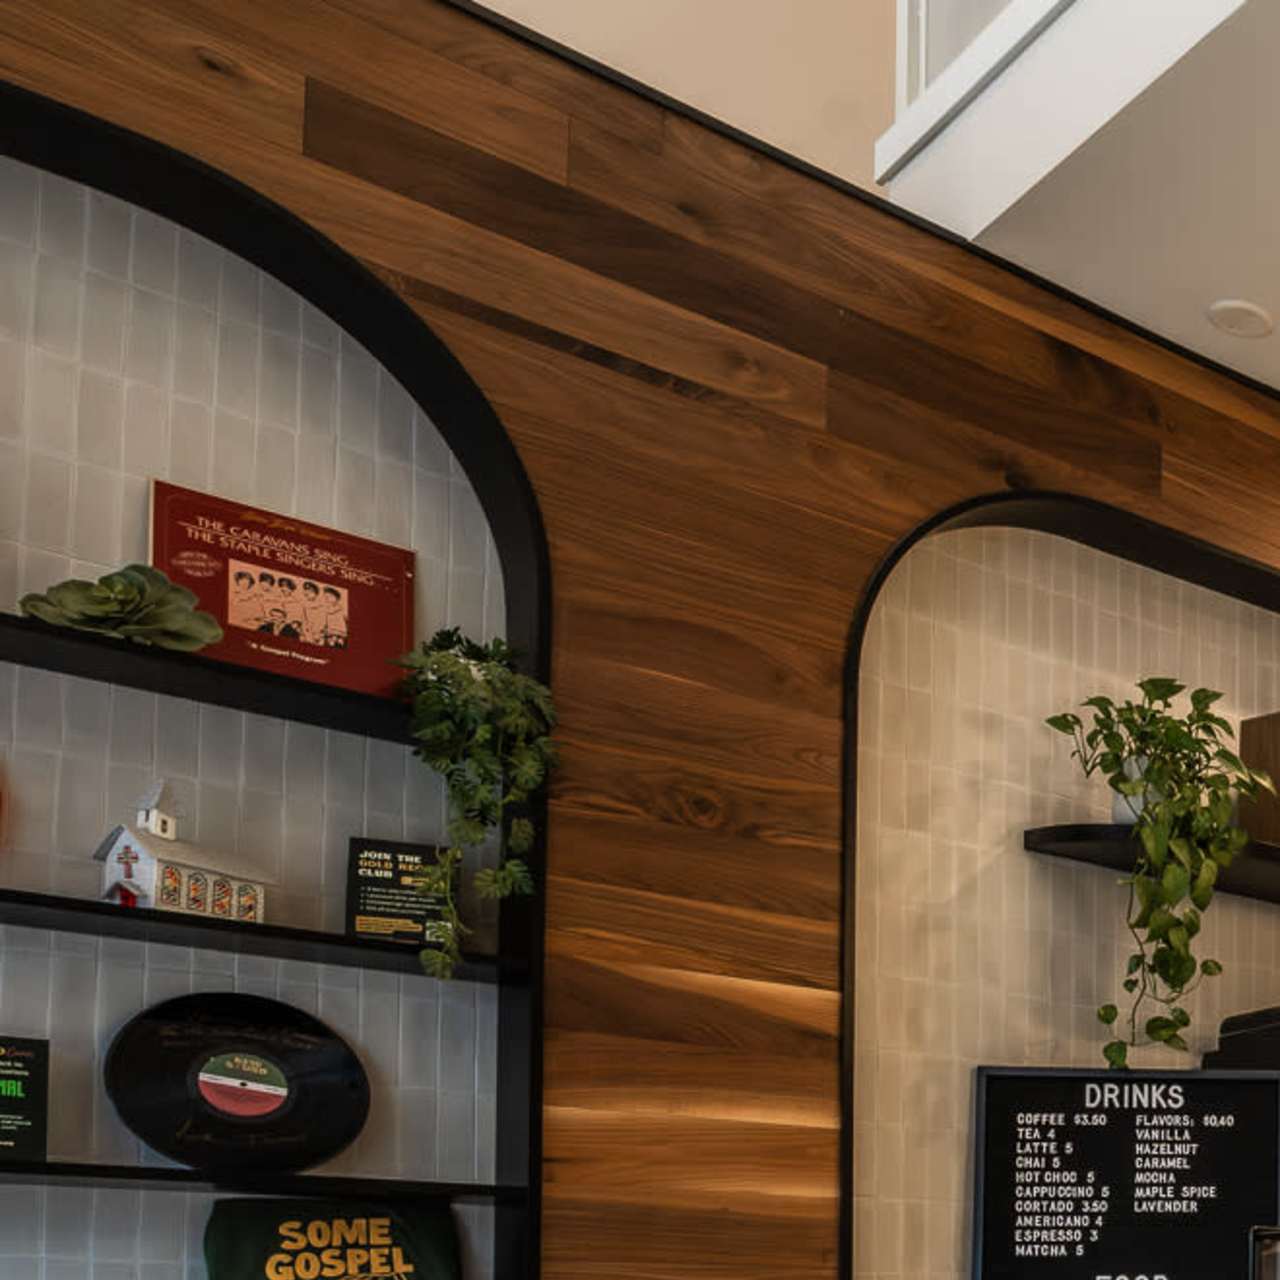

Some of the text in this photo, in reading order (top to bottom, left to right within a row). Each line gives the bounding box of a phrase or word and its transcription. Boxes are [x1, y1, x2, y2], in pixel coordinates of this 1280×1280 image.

[197, 516, 225, 532] THE
[230, 526, 311, 555] CARAVANS
[185, 527, 215, 544] THE
[276, 550, 336, 576] SINGERS
[358, 850, 392, 861] JOIN
[358, 868, 393, 879] CLUB
[1085, 1083, 1185, 1109] DRINKS
[1016, 1113, 1065, 1126] COFFEE
[1017, 1128, 1056, 1140] TEA 4
[1135, 1129, 1191, 1141] VANILLA
[1016, 1142, 1074, 1154] LATTE 5
[1135, 1144, 1199, 1156] HAZELNUT
[1016, 1157, 1061, 1168] CHAI 5
[1135, 1157, 1191, 1169] CARAMEL
[1016, 1171, 1095, 1183] HOT CHOC 5
[1134, 1172, 1176, 1184] MOCHA
[1016, 1186, 1110, 1198] CAPPUCCINO 5
[1134, 1186, 1217, 1198] MAPLE SPICE
[1015, 1201, 1074, 1213] CORTADO
[1134, 1201, 1199, 1213] LAVENDER
[1015, 1215, 1104, 1227] AMERICANO 4
[278, 1217, 393, 1250] SOME
[1015, 1230, 1099, 1242] ESPRESSO 3
[1015, 1244, 1084, 1256] MATCHA 5
